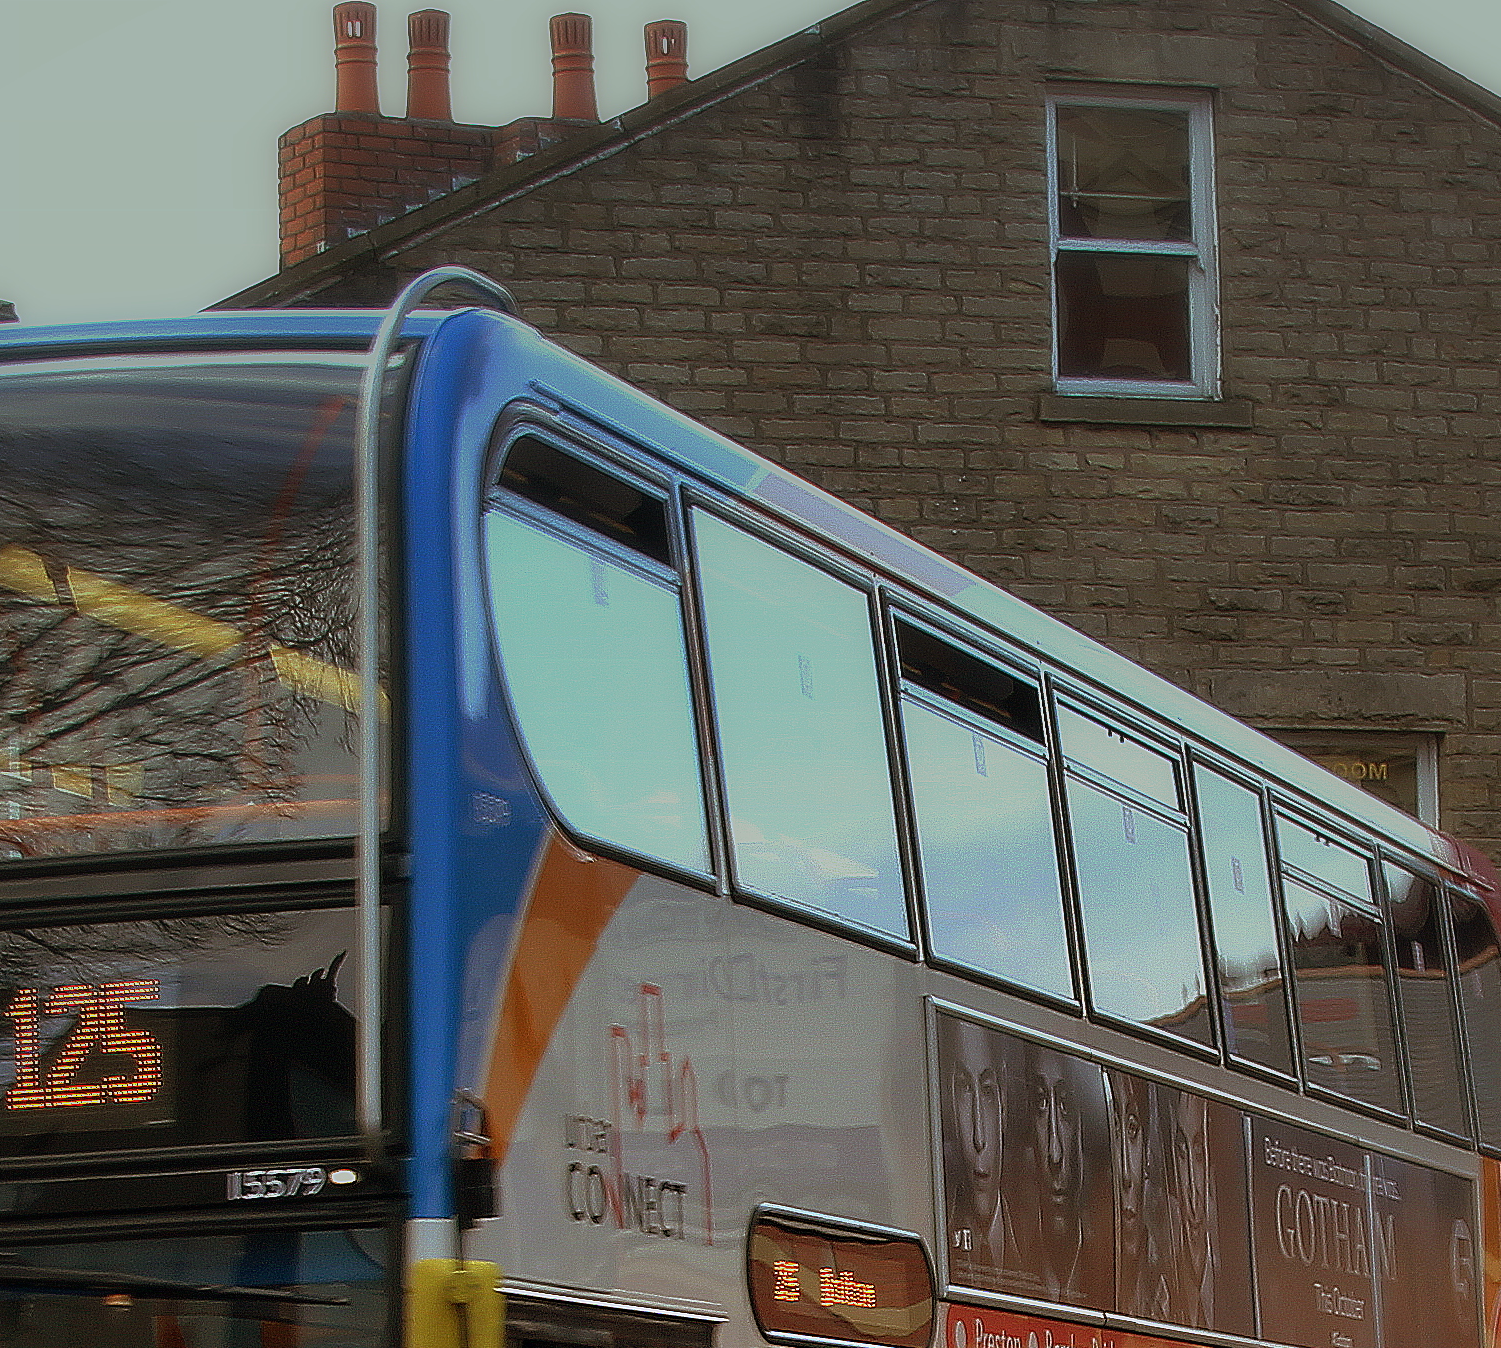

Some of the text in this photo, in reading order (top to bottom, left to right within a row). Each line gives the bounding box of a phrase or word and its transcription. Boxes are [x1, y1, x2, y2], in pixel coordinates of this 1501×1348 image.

[4, 979, 163, 1112] 125
[228, 1168, 326, 1200] 15579
[1277, 1184, 1397, 1281] GOTHAM
